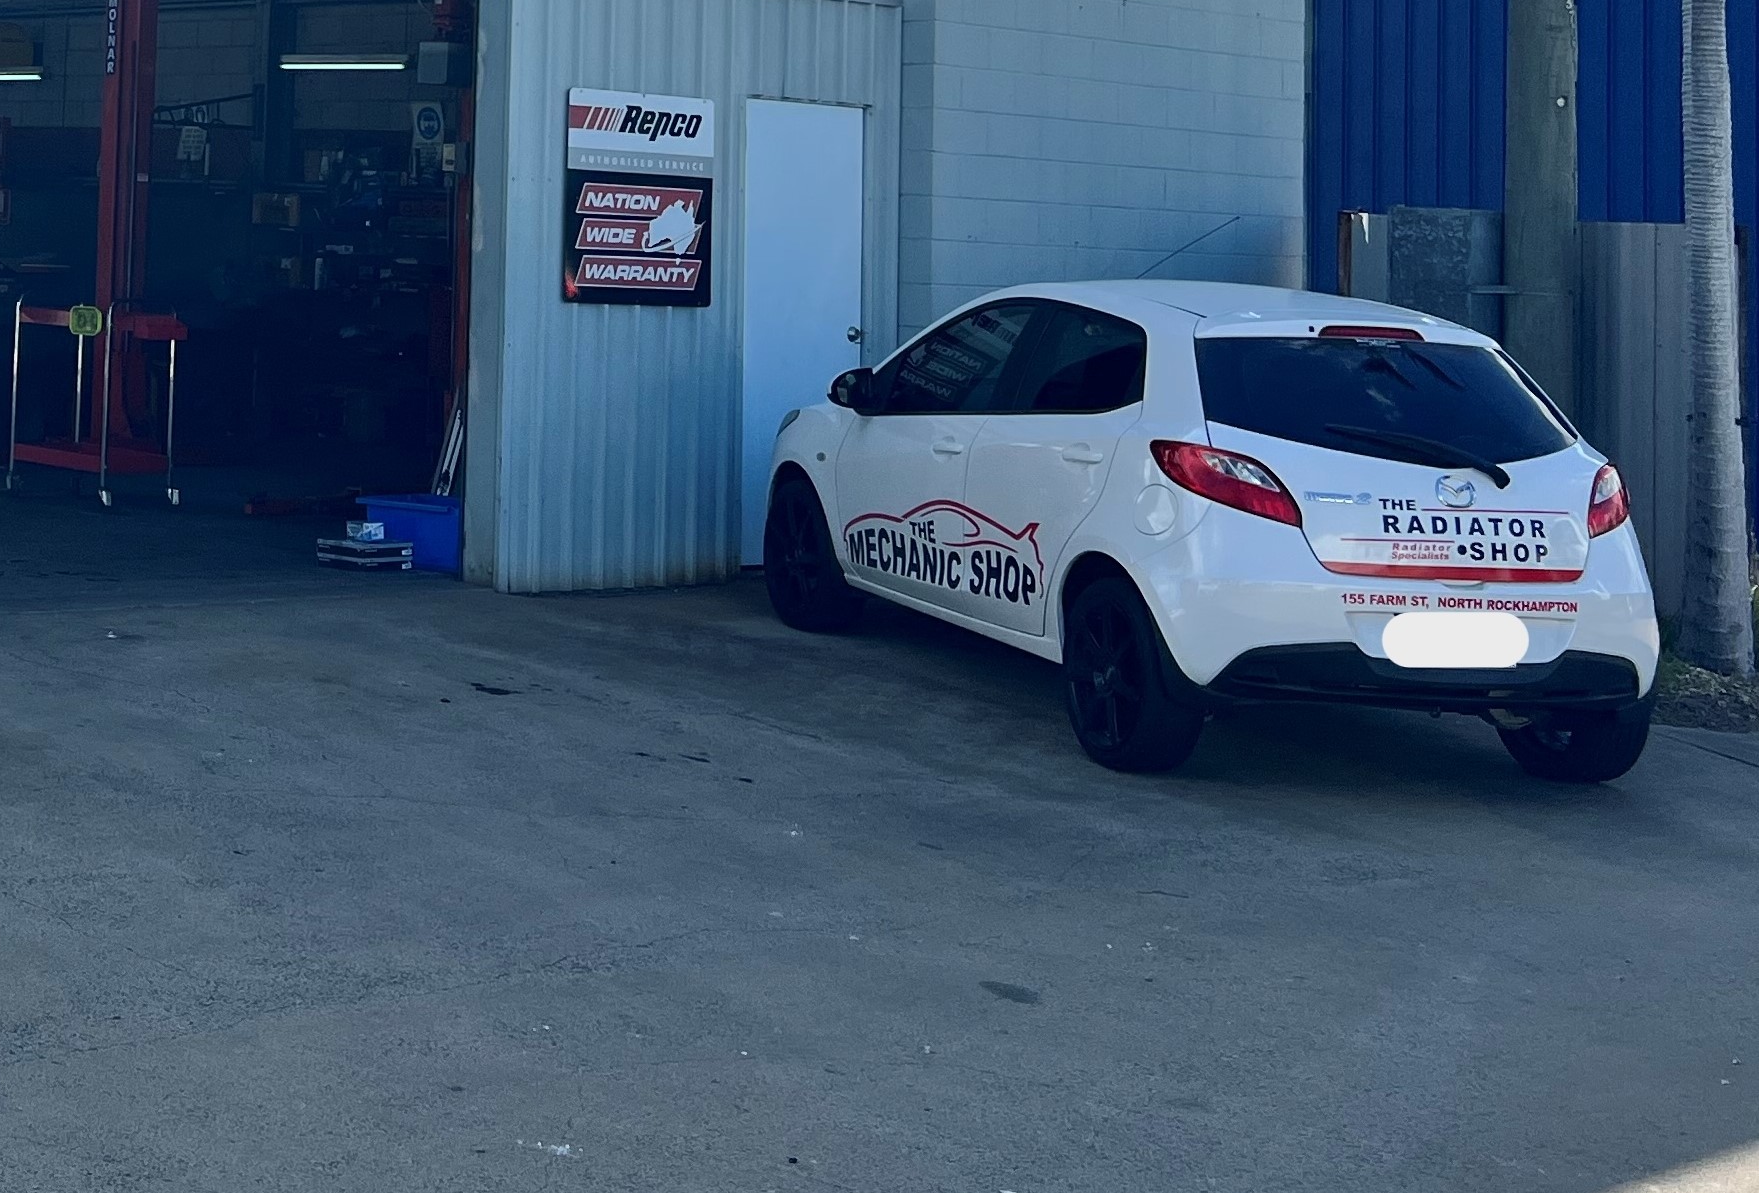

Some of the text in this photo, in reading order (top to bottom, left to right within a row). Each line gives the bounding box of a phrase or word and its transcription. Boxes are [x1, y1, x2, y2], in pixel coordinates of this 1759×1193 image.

[619, 104, 703, 142] Repco
[580, 153, 704, 172] AUTHORISED SERVICE
[584, 191, 661, 211] NATION
[586, 226, 637, 244] WIDE
[585, 263, 695, 284] WARRANTY
[1378, 498, 1417, 511] THE
[908, 520, 937, 544] THE
[1382, 514, 1546, 539] RADIATOR
[1391, 551, 1450, 561] Specialists
[1392, 542, 1451, 553] Radiator
[1469, 542, 1549, 563] SHOP
[848, 527, 1036, 606] MECHANIC SHOP
[1341, 593, 1578, 613] 155 FARM ST, NORTH ROCKHAMPTON
